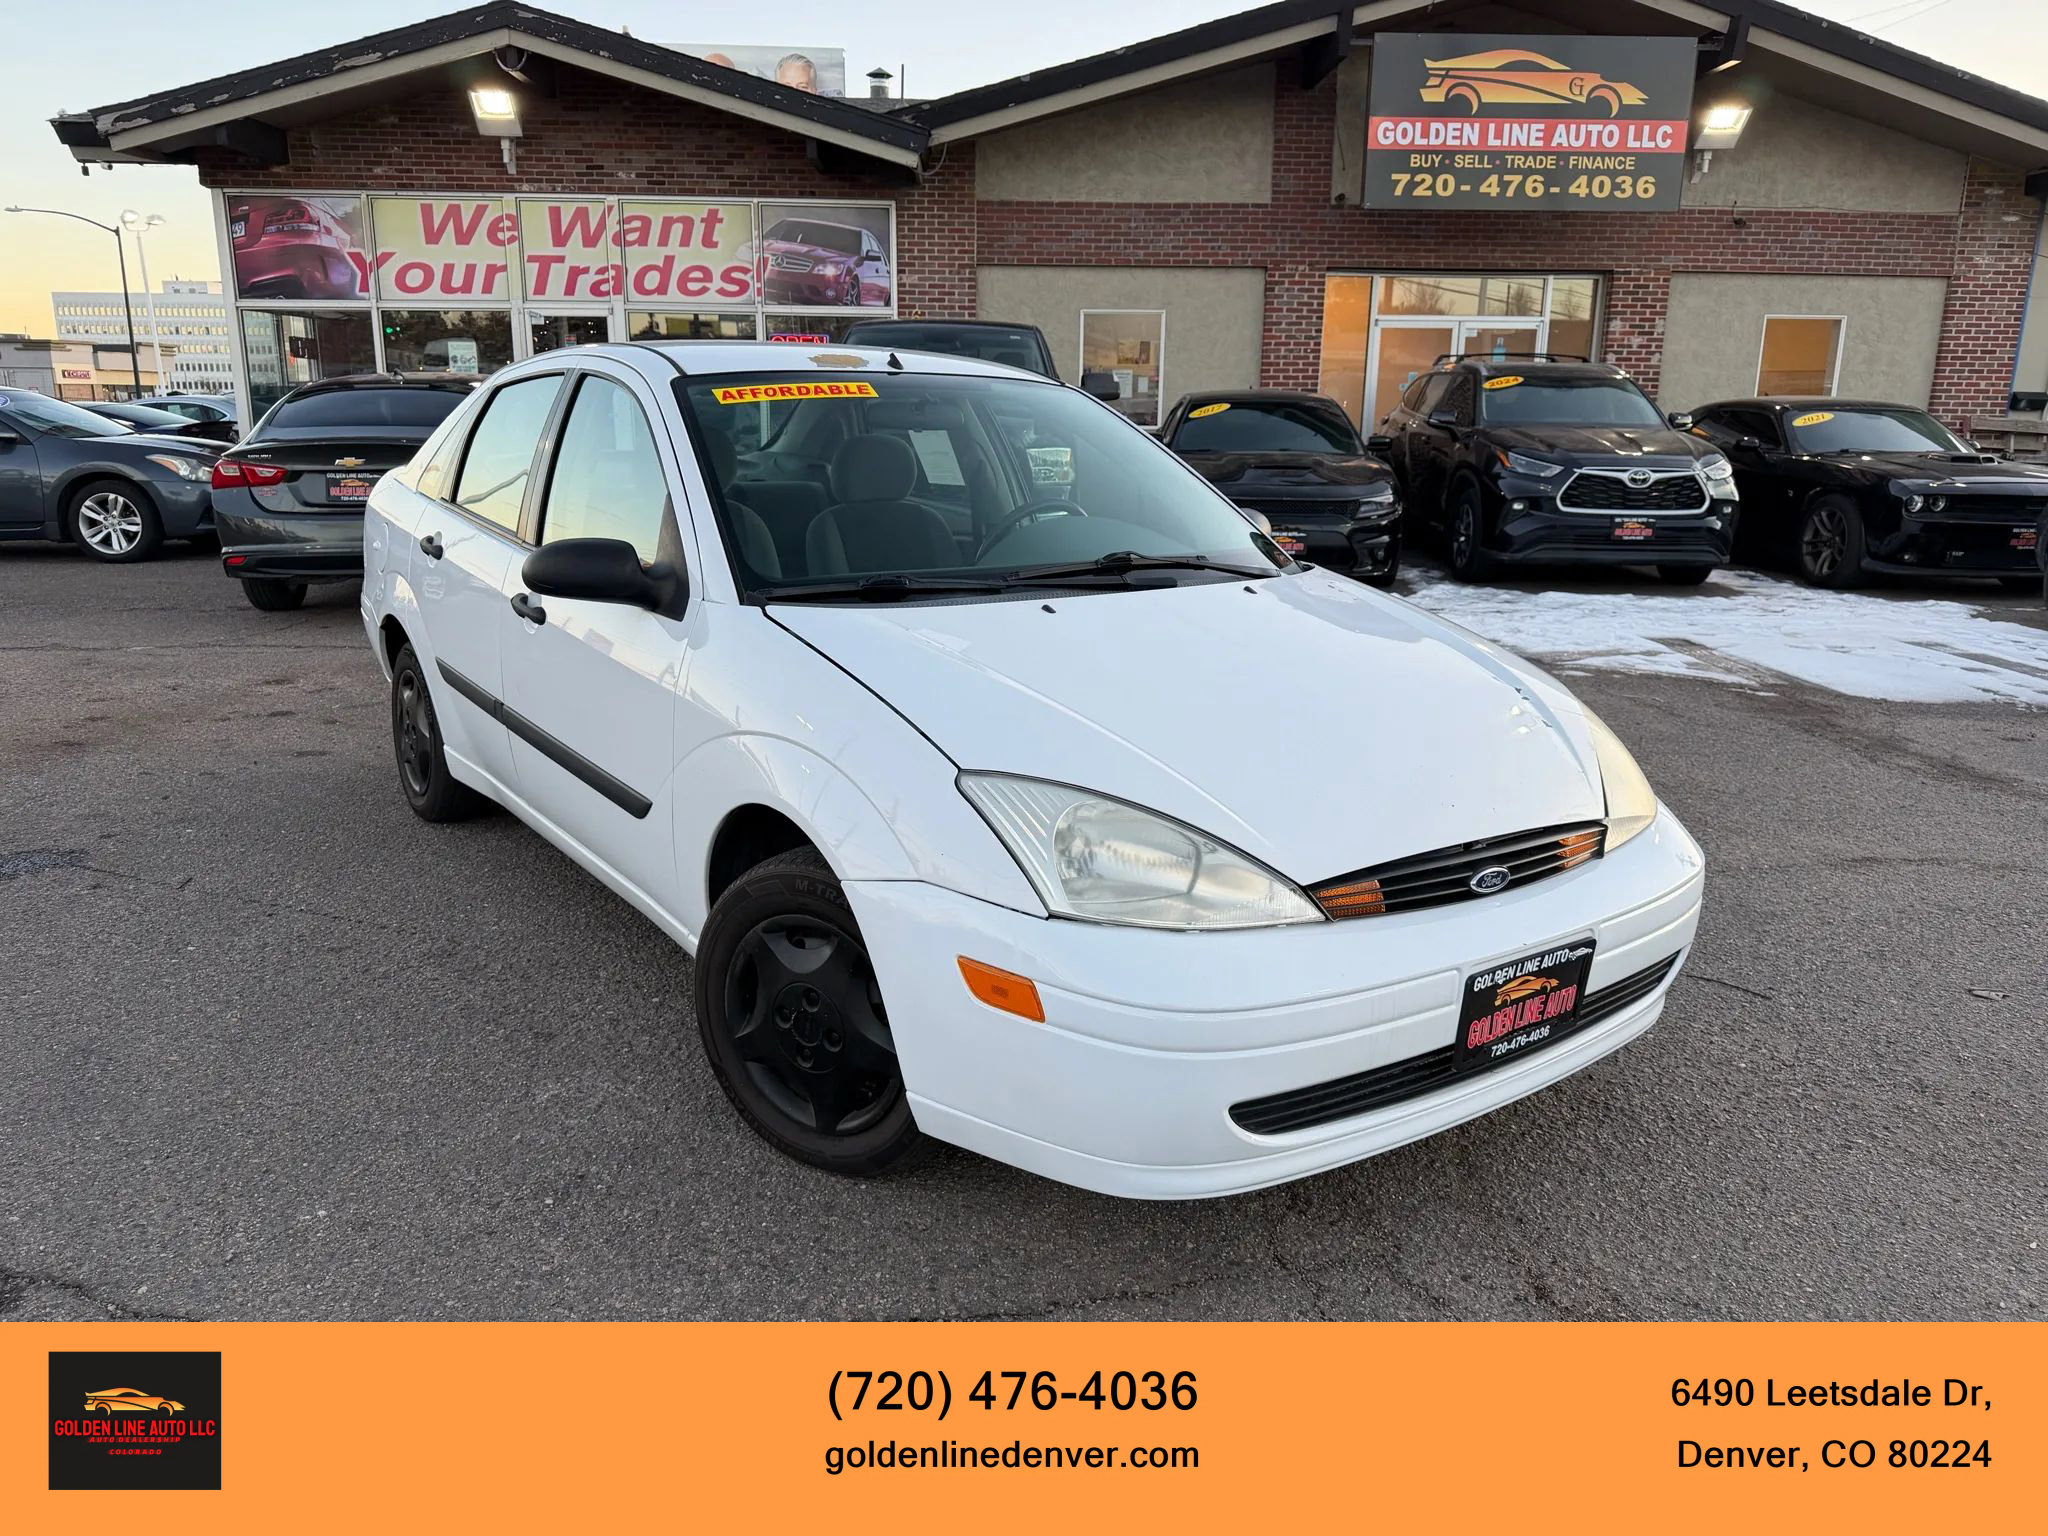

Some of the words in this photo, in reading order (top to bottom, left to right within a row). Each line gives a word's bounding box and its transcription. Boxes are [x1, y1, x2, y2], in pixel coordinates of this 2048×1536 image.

[1377, 121, 1480, 146] GOLDEN
[1487, 123, 1545, 147] LINE
[1551, 124, 1620, 148] AUTO
[1627, 125, 1673, 149] LLC
[1410, 154, 1443, 168] BUY
[1454, 155, 1493, 169] SELL
[1505, 155, 1557, 169] TRADE
[1569, 156, 1636, 170] FINANCE
[1391, 173, 1656, 199] 720-476-4036
[420, 203, 519, 247] We
[547, 205, 724, 249] Want
[347, 251, 508, 295] Your
[721, 382, 873, 401] AFFORDABLE
[1487, 377, 1520, 387] 2024
[1481, 872, 1503, 888] Ford
[1474, 968, 1514, 992] GOLDEN
[1516, 957, 1541, 976] LINE
[1541, 948, 1569, 969] AUTO
[1467, 1006, 1517, 1049] GOLDEN
[1514, 994, 1546, 1030] LINE
[1543, 984, 1577, 1020] AUTO
[1491, 1025, 1551, 1058] 720-476-4036
